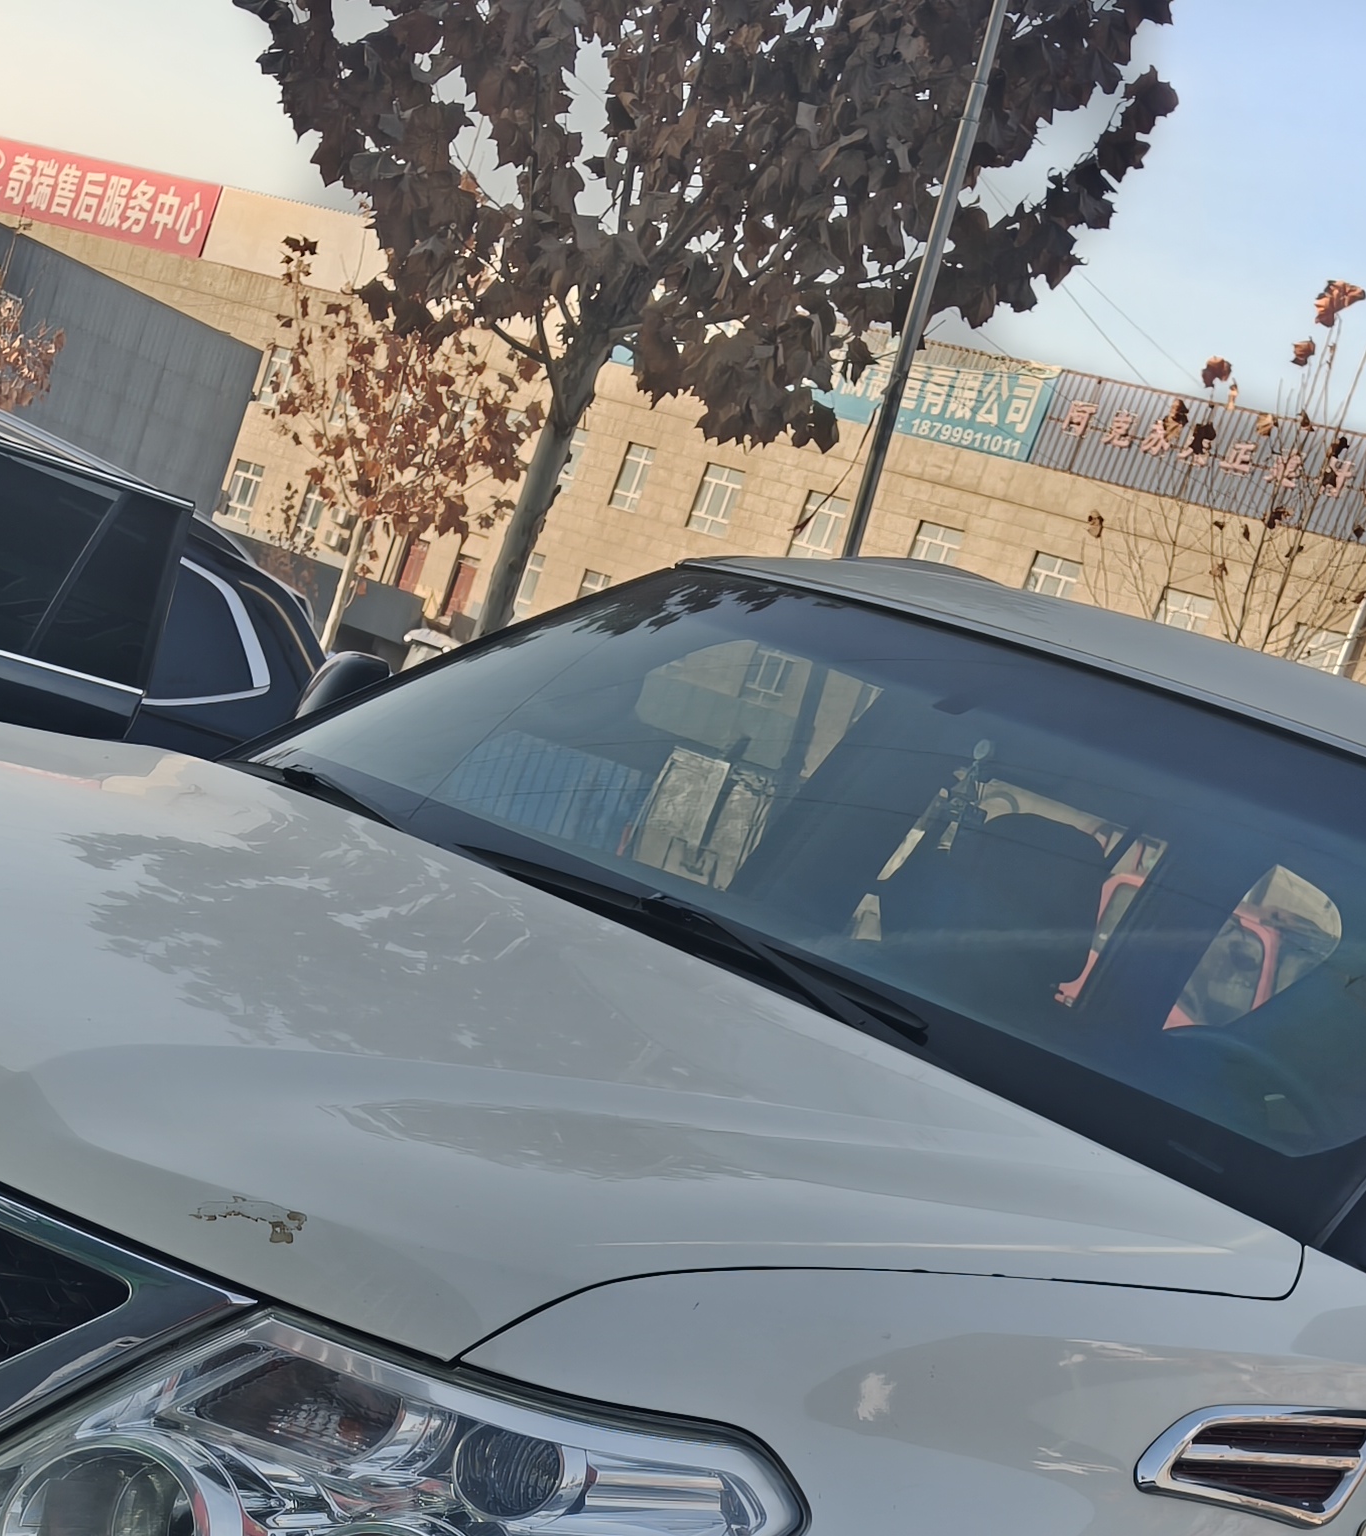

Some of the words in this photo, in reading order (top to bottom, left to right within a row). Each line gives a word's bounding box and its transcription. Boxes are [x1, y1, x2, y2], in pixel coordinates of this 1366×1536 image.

[4, 153, 204, 244] 奇瑞售后服务中心
